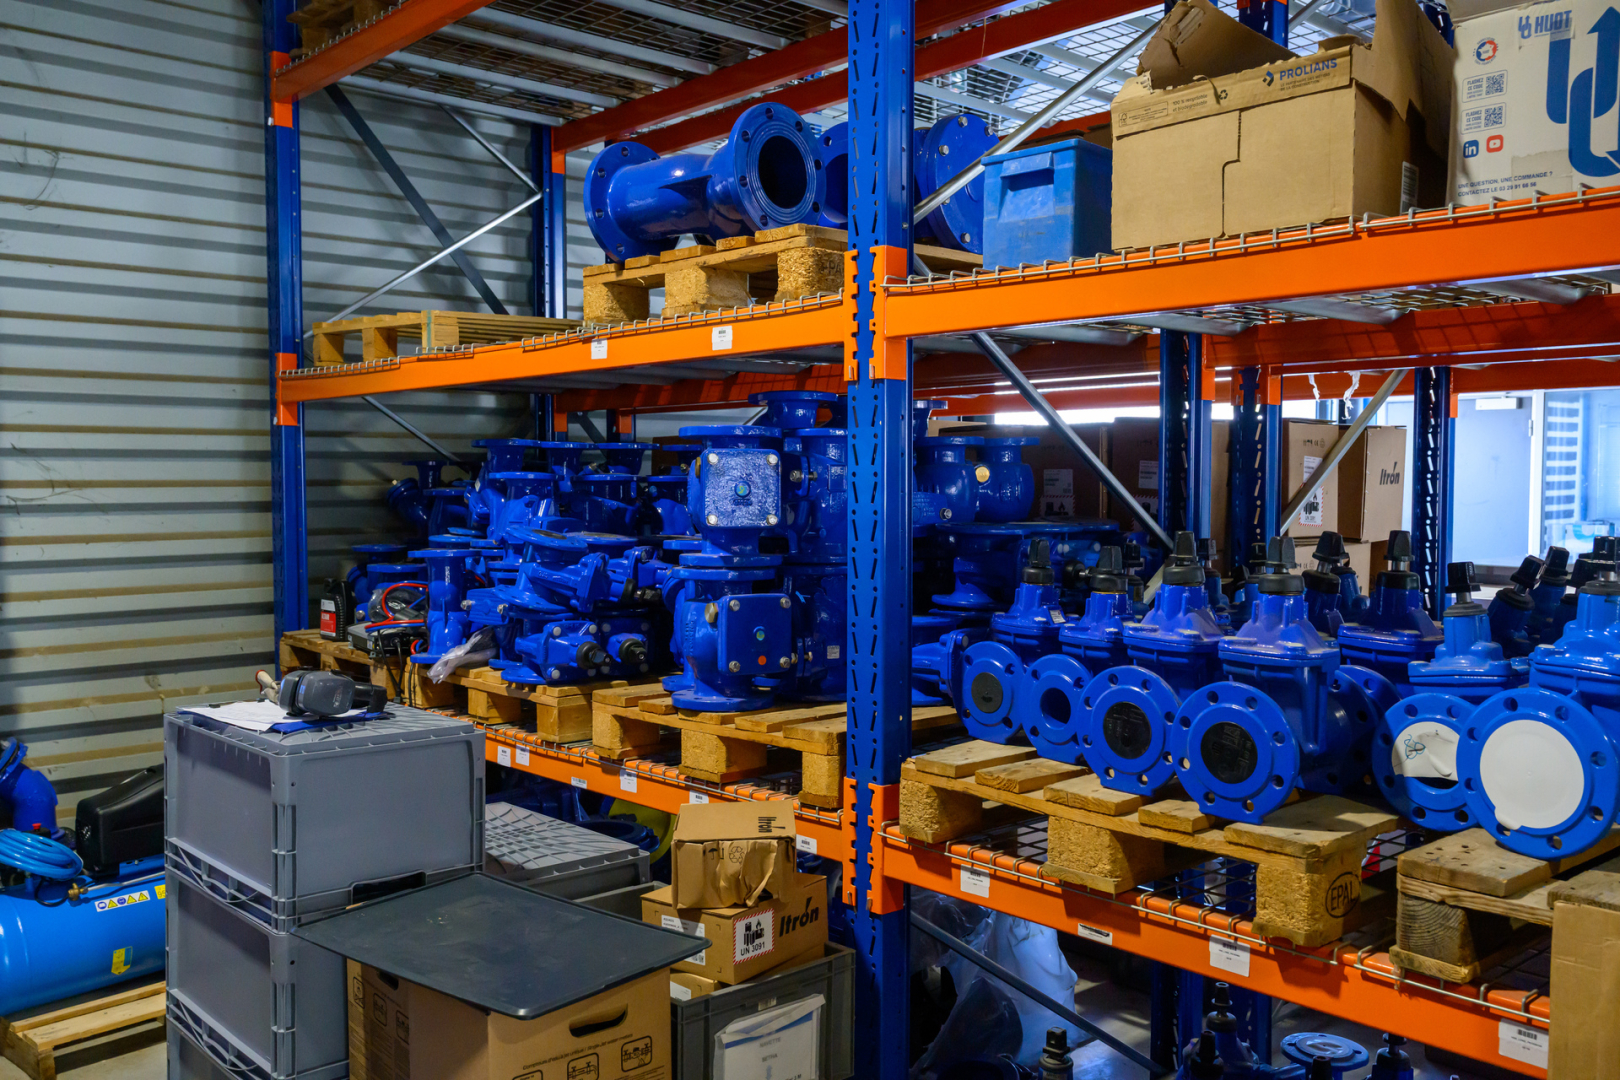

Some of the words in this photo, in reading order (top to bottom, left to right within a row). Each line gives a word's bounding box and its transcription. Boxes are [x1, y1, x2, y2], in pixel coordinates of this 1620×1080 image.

[1534, 10, 1572, 34] HUOT
[1280, 58, 1338, 81] PROLIANS
[1513, 171, 1548, 182] COMMANDE
[1458, 187, 1490, 197] CONTACTEZ
[1331, 880, 1356, 911] EPAL
[740, 946, 750, 956] UN
[751, 941, 765, 953] 3091
